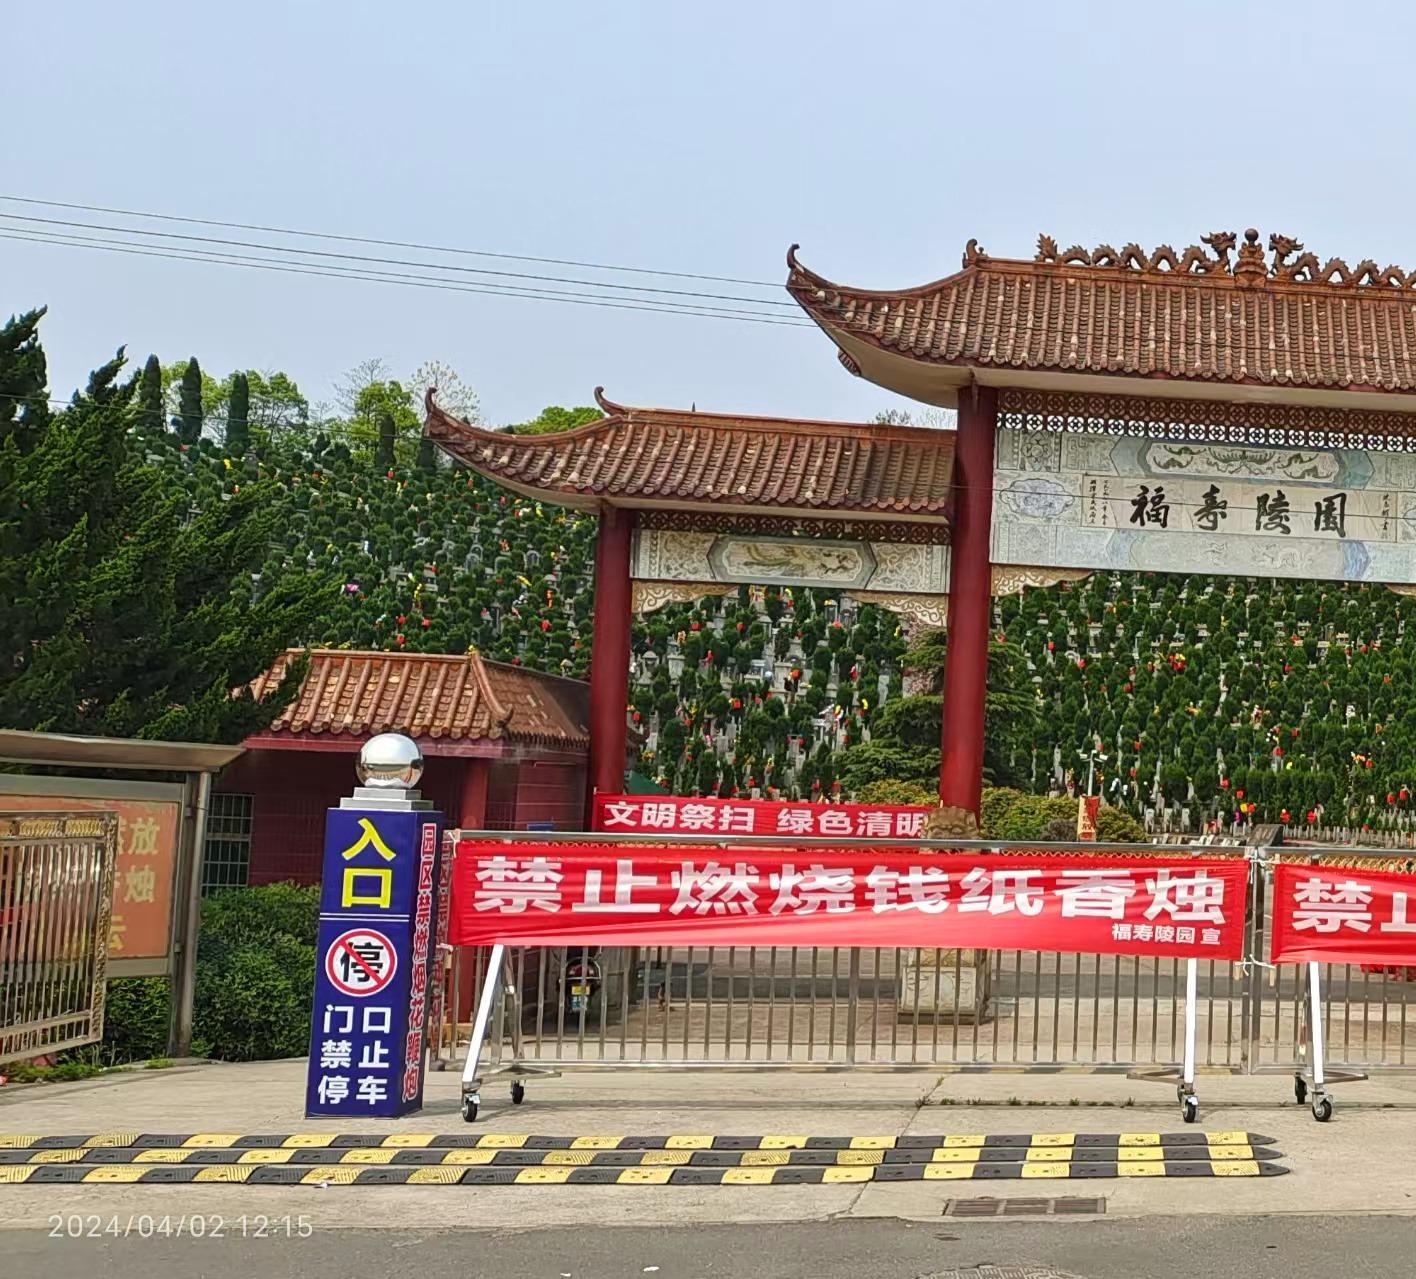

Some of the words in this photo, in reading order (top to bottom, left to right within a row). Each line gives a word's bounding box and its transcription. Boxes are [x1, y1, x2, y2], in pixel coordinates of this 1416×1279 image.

[604, 800, 755, 832] 文明祭扫
[777, 806, 924, 837] 绿色清明
[341, 818, 397, 908] 入口
[473, 856, 1226, 925] 禁止燃烧钱纸香烛
[1112, 923, 1195, 944] 福寿陵园
[1201, 928, 1221, 945] 宣
[340, 942, 384, 982] 停
[402, 823, 437, 1102] 园区禁燃烟花鞭炮
[323, 1004, 391, 1034] 门口
[320, 1040, 389, 1069] 禁止
[318, 1075, 387, 1105] 停车
